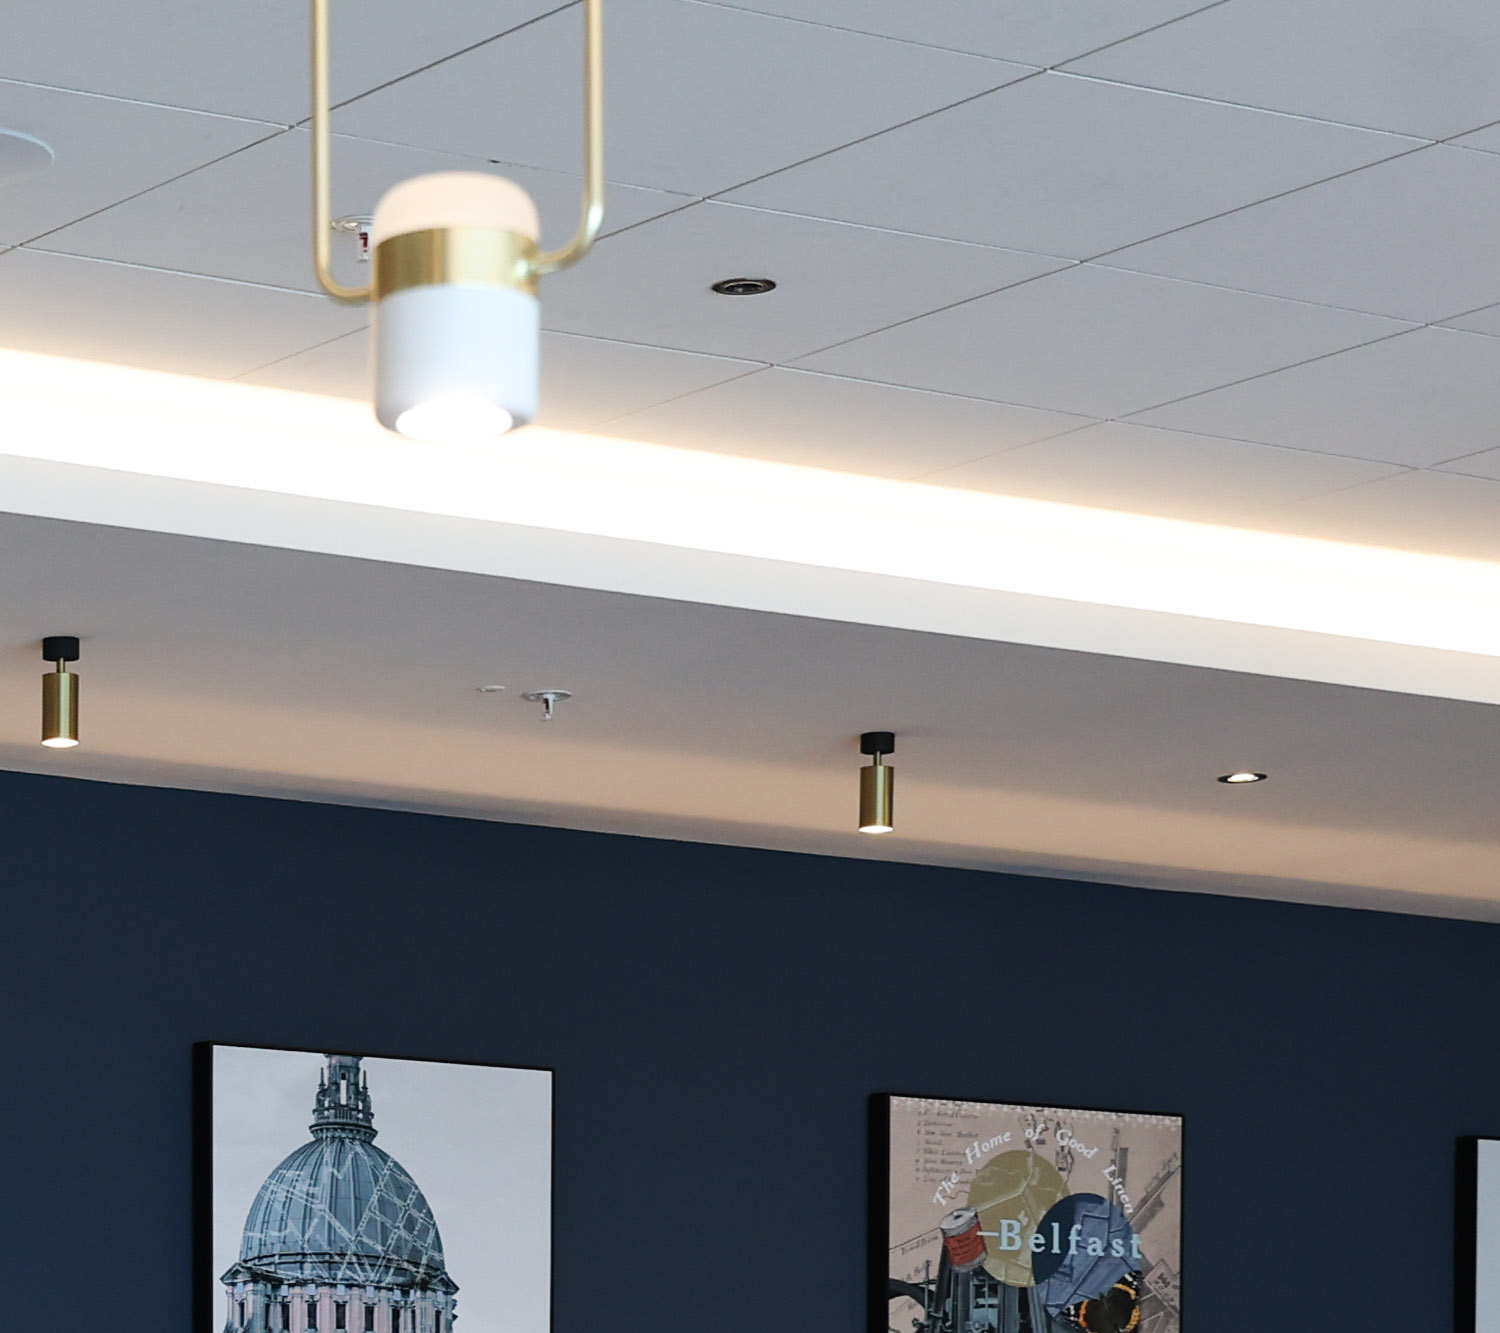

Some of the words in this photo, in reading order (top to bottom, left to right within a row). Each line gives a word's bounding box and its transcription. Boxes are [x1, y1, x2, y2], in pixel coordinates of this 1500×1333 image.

[932, 1171, 961, 1206] The
[964, 1131, 1013, 1165] Home
[1025, 1123, 1046, 1141] of
[1056, 1129, 1099, 1159] Good
[1103, 1164, 1135, 1214] Linen
[999, 1218, 1143, 1259] Belfast
